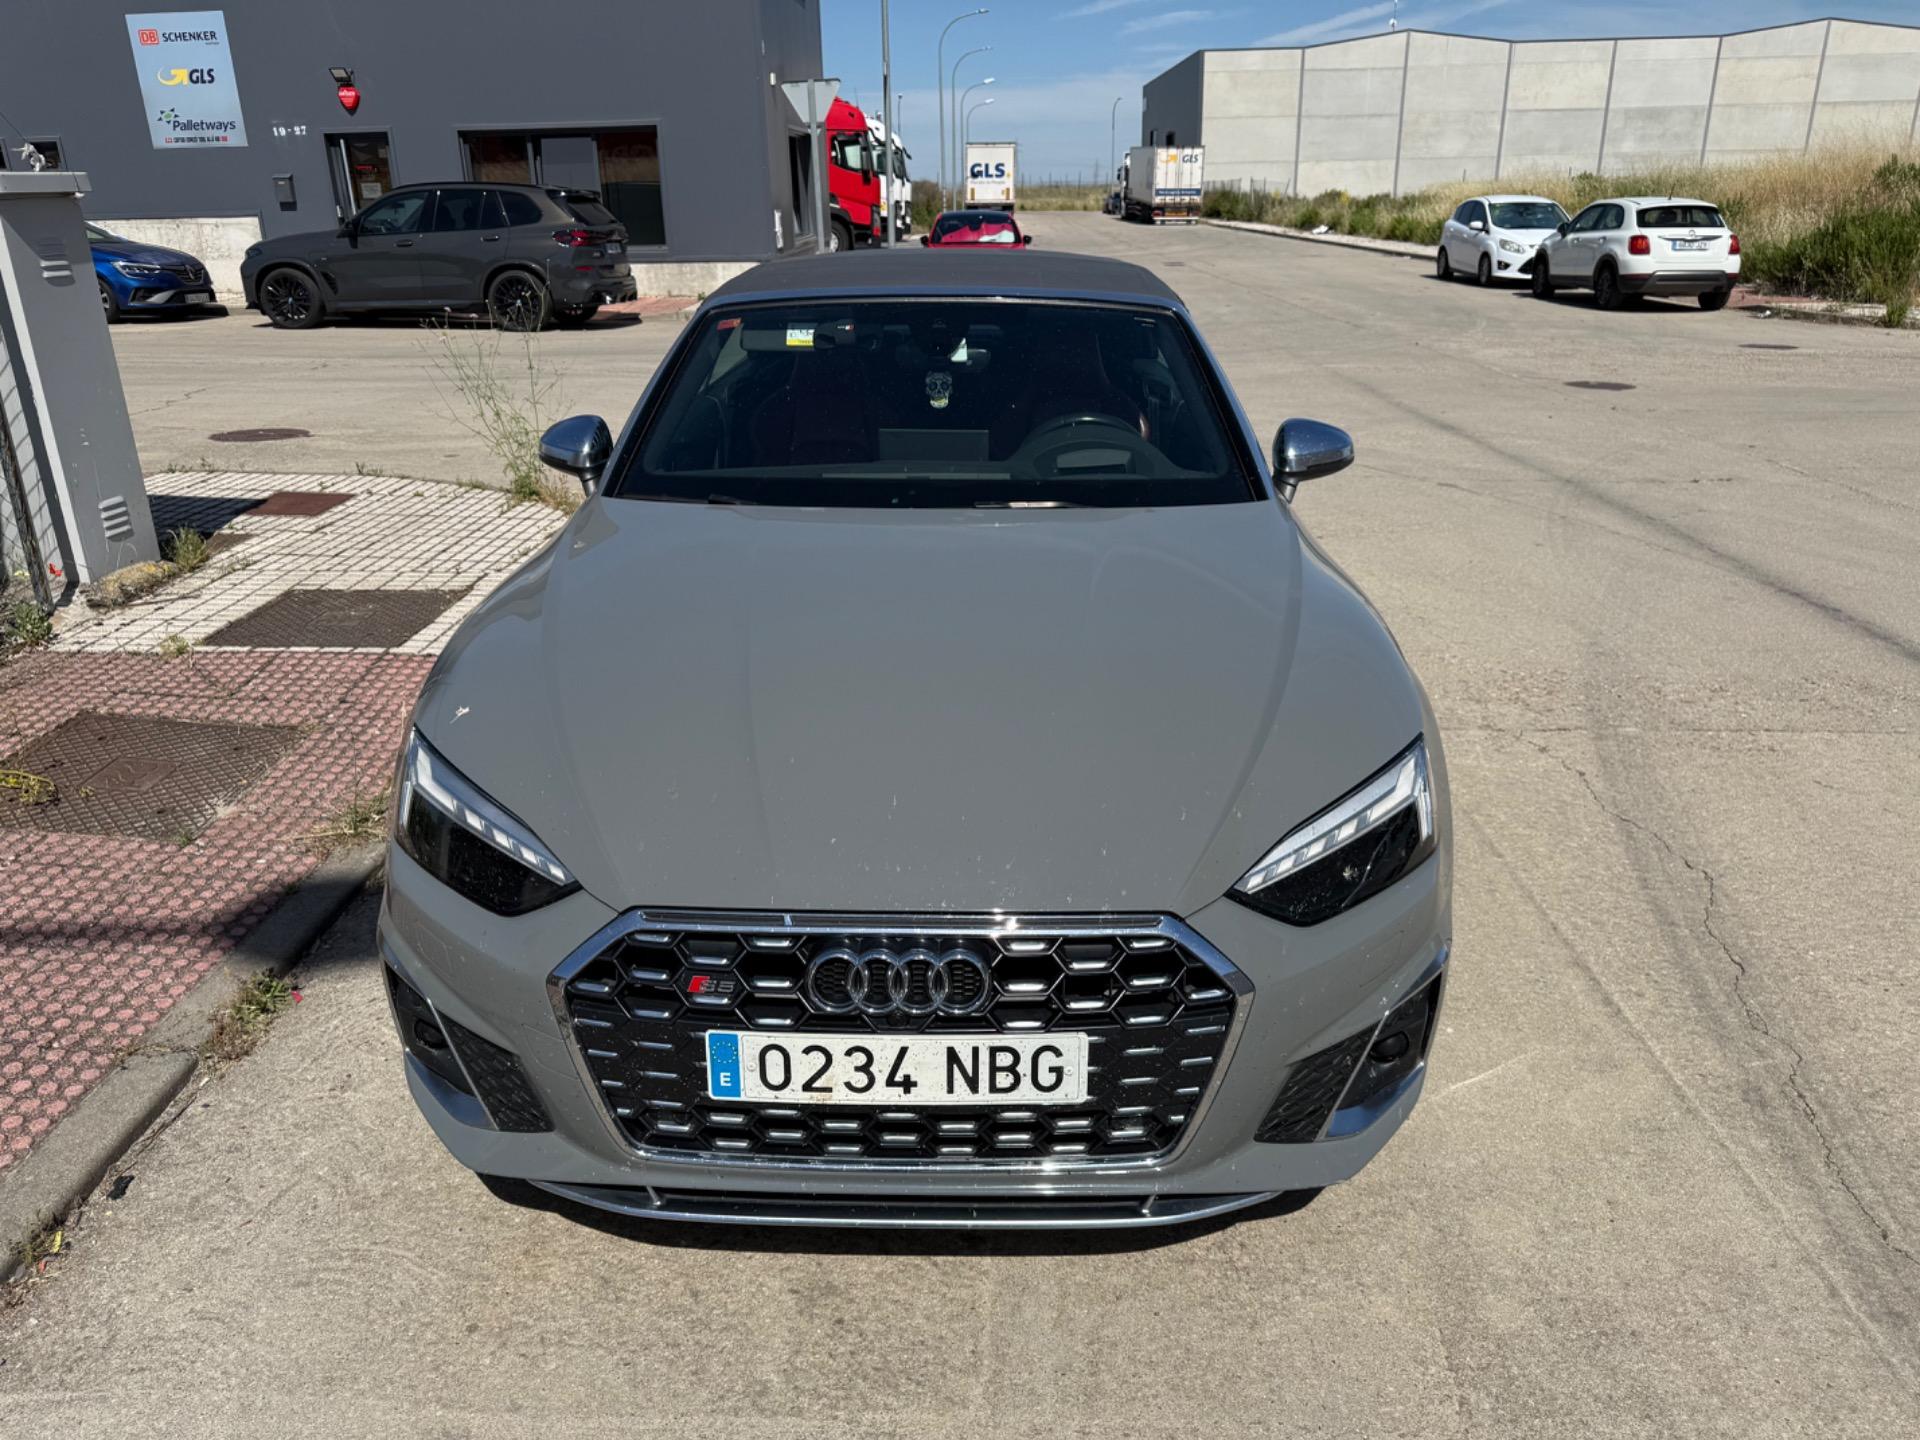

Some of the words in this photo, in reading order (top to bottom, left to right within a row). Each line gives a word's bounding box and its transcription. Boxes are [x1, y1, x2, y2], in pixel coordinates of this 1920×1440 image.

[140, 31, 157, 43] DB
[162, 31, 218, 43] SCHENKER
[189, 68, 215, 84] GLS
[172, 119, 236, 133] Palletways
[1182, 154, 1199, 163] GLS
[758, 1043, 918, 1095] 0234
[946, 1044, 1065, 1096] NBG
[720, 1073, 732, 1087] E
